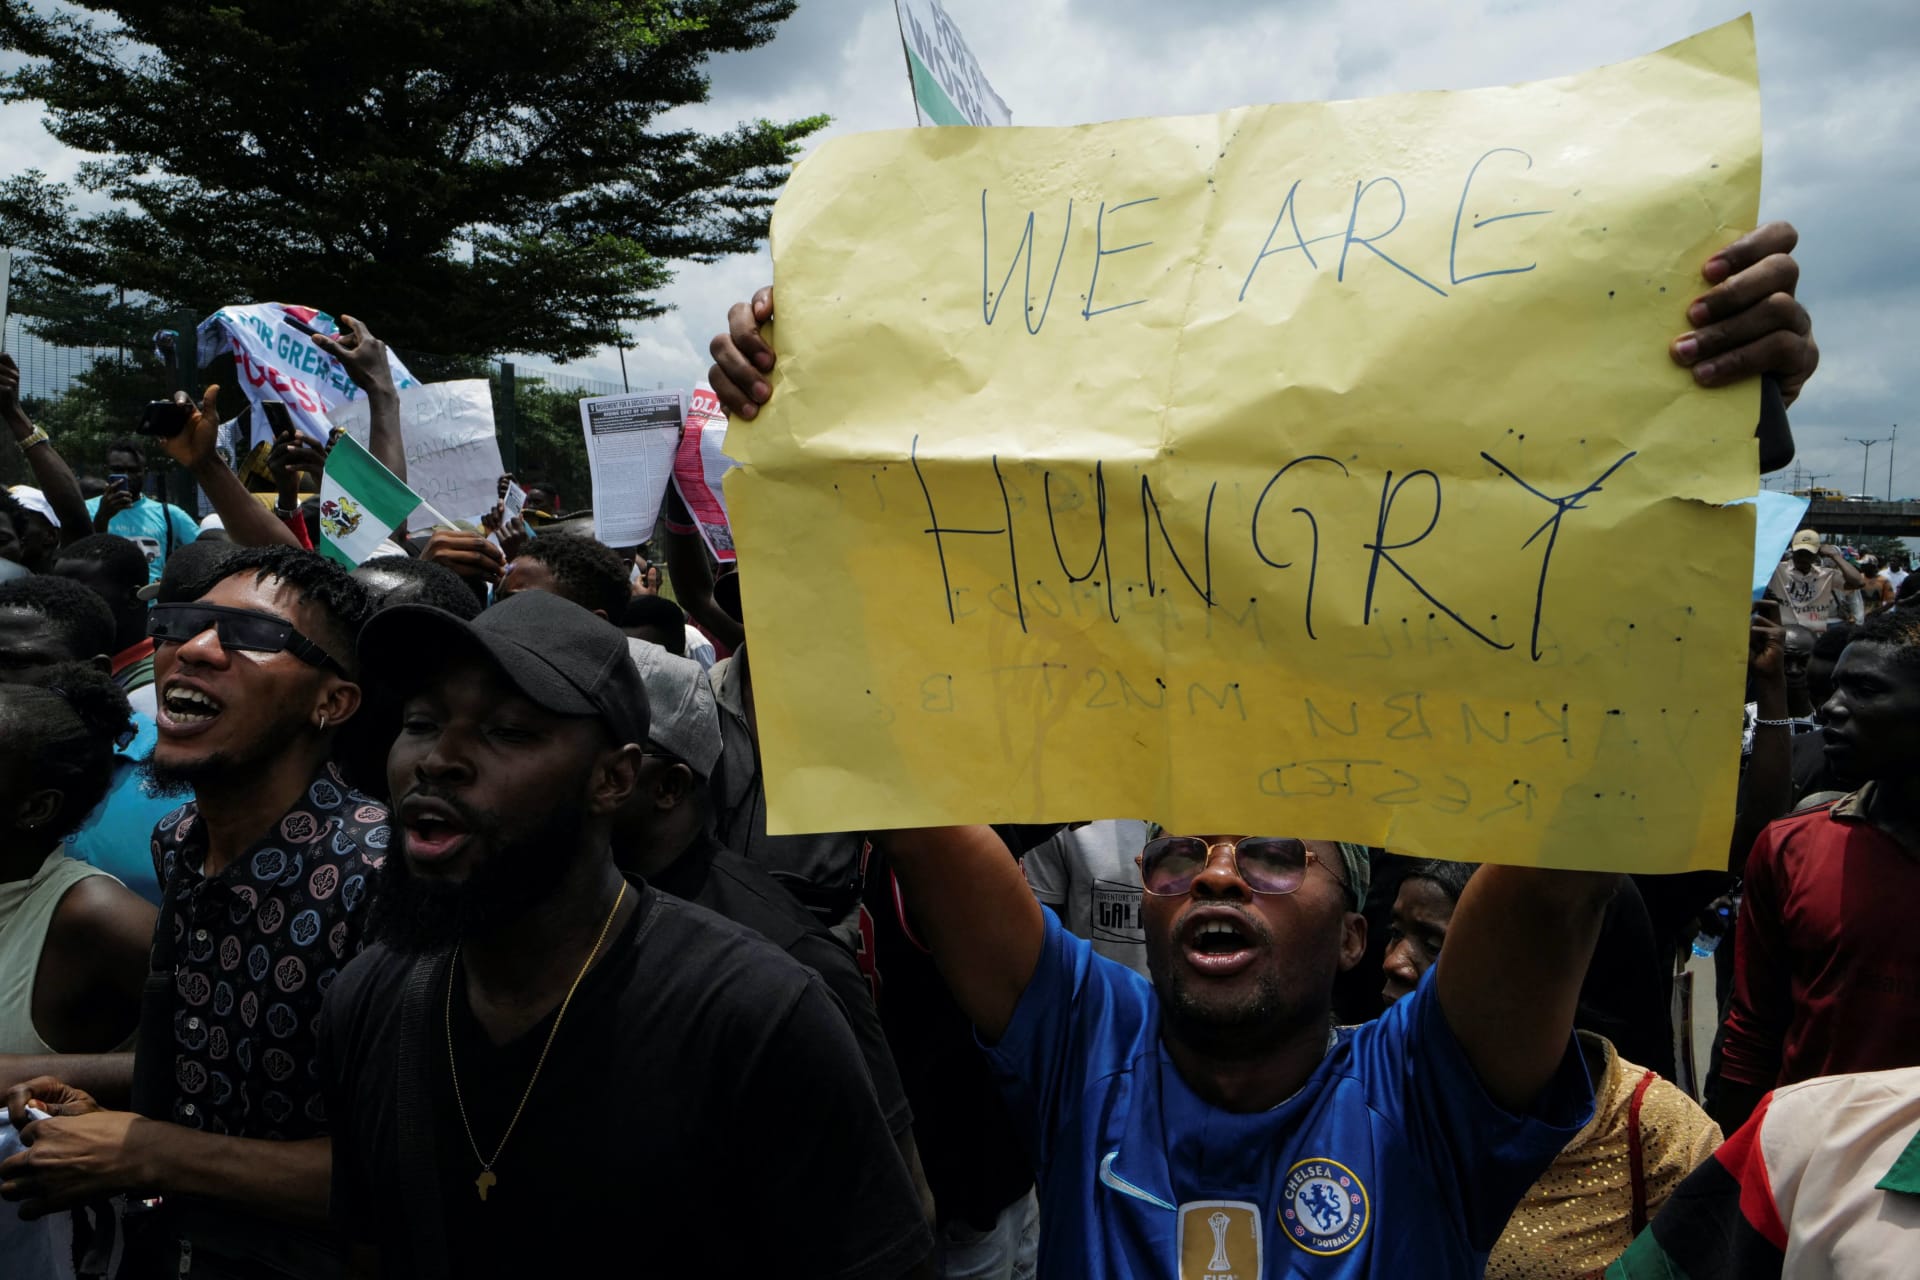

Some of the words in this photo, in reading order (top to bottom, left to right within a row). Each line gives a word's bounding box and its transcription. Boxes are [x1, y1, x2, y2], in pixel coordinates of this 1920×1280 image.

[905, 3, 993, 126] WORK
[981, 188, 1160, 336] WE
[1237, 146, 1555, 303] ARE
[417, 476, 465, 501] 024
[911, 433, 1640, 662] HUNGRY
[1284, 1165, 1332, 1200] CHELSEA
[1312, 1233, 1351, 1248] FOOTBALL
[1348, 1212, 1361, 1235] CLUB
